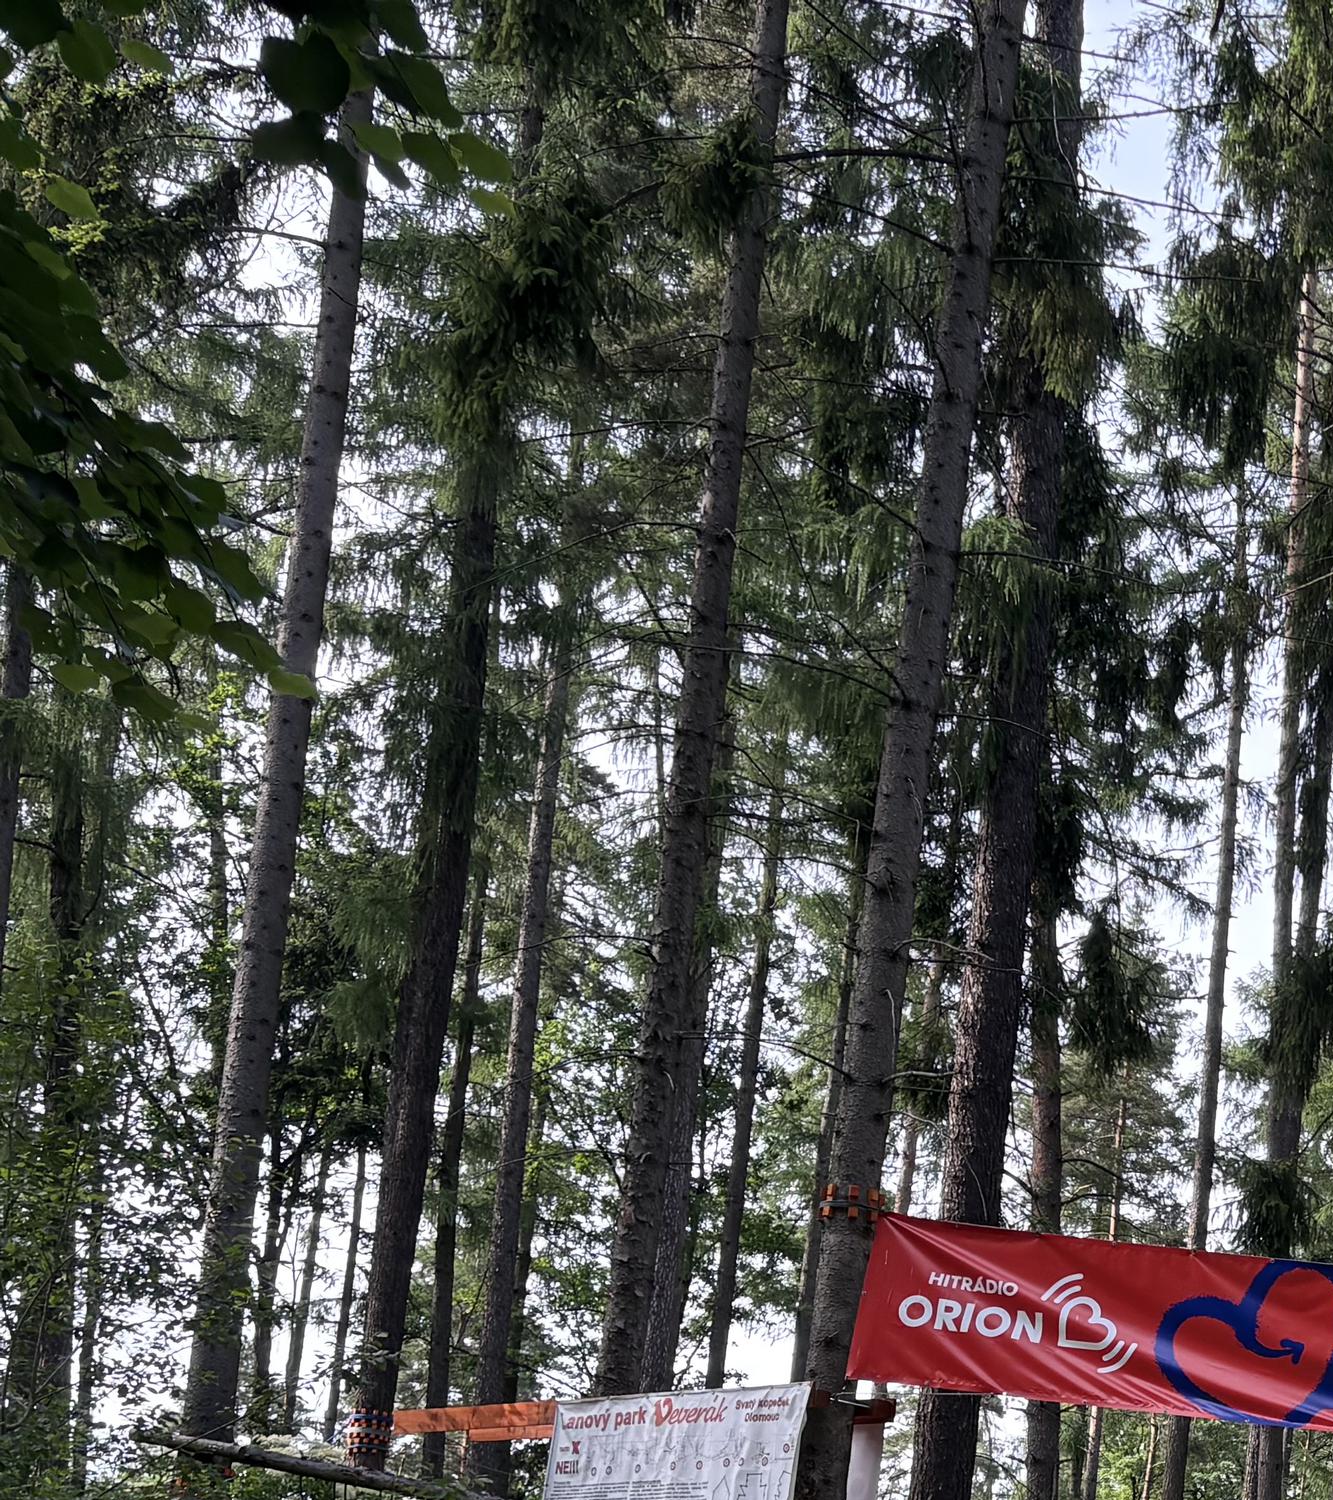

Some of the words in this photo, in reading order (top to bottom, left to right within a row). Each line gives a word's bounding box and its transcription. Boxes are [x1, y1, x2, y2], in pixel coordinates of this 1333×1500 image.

[928, 1271, 1019, 1297] HITRÁDIO
[898, 1294, 1044, 1344] ORION
[560, 1408, 611, 1431] Lanový
[614, 1406, 648, 1431] park
[654, 1395, 728, 1427] Veverák
